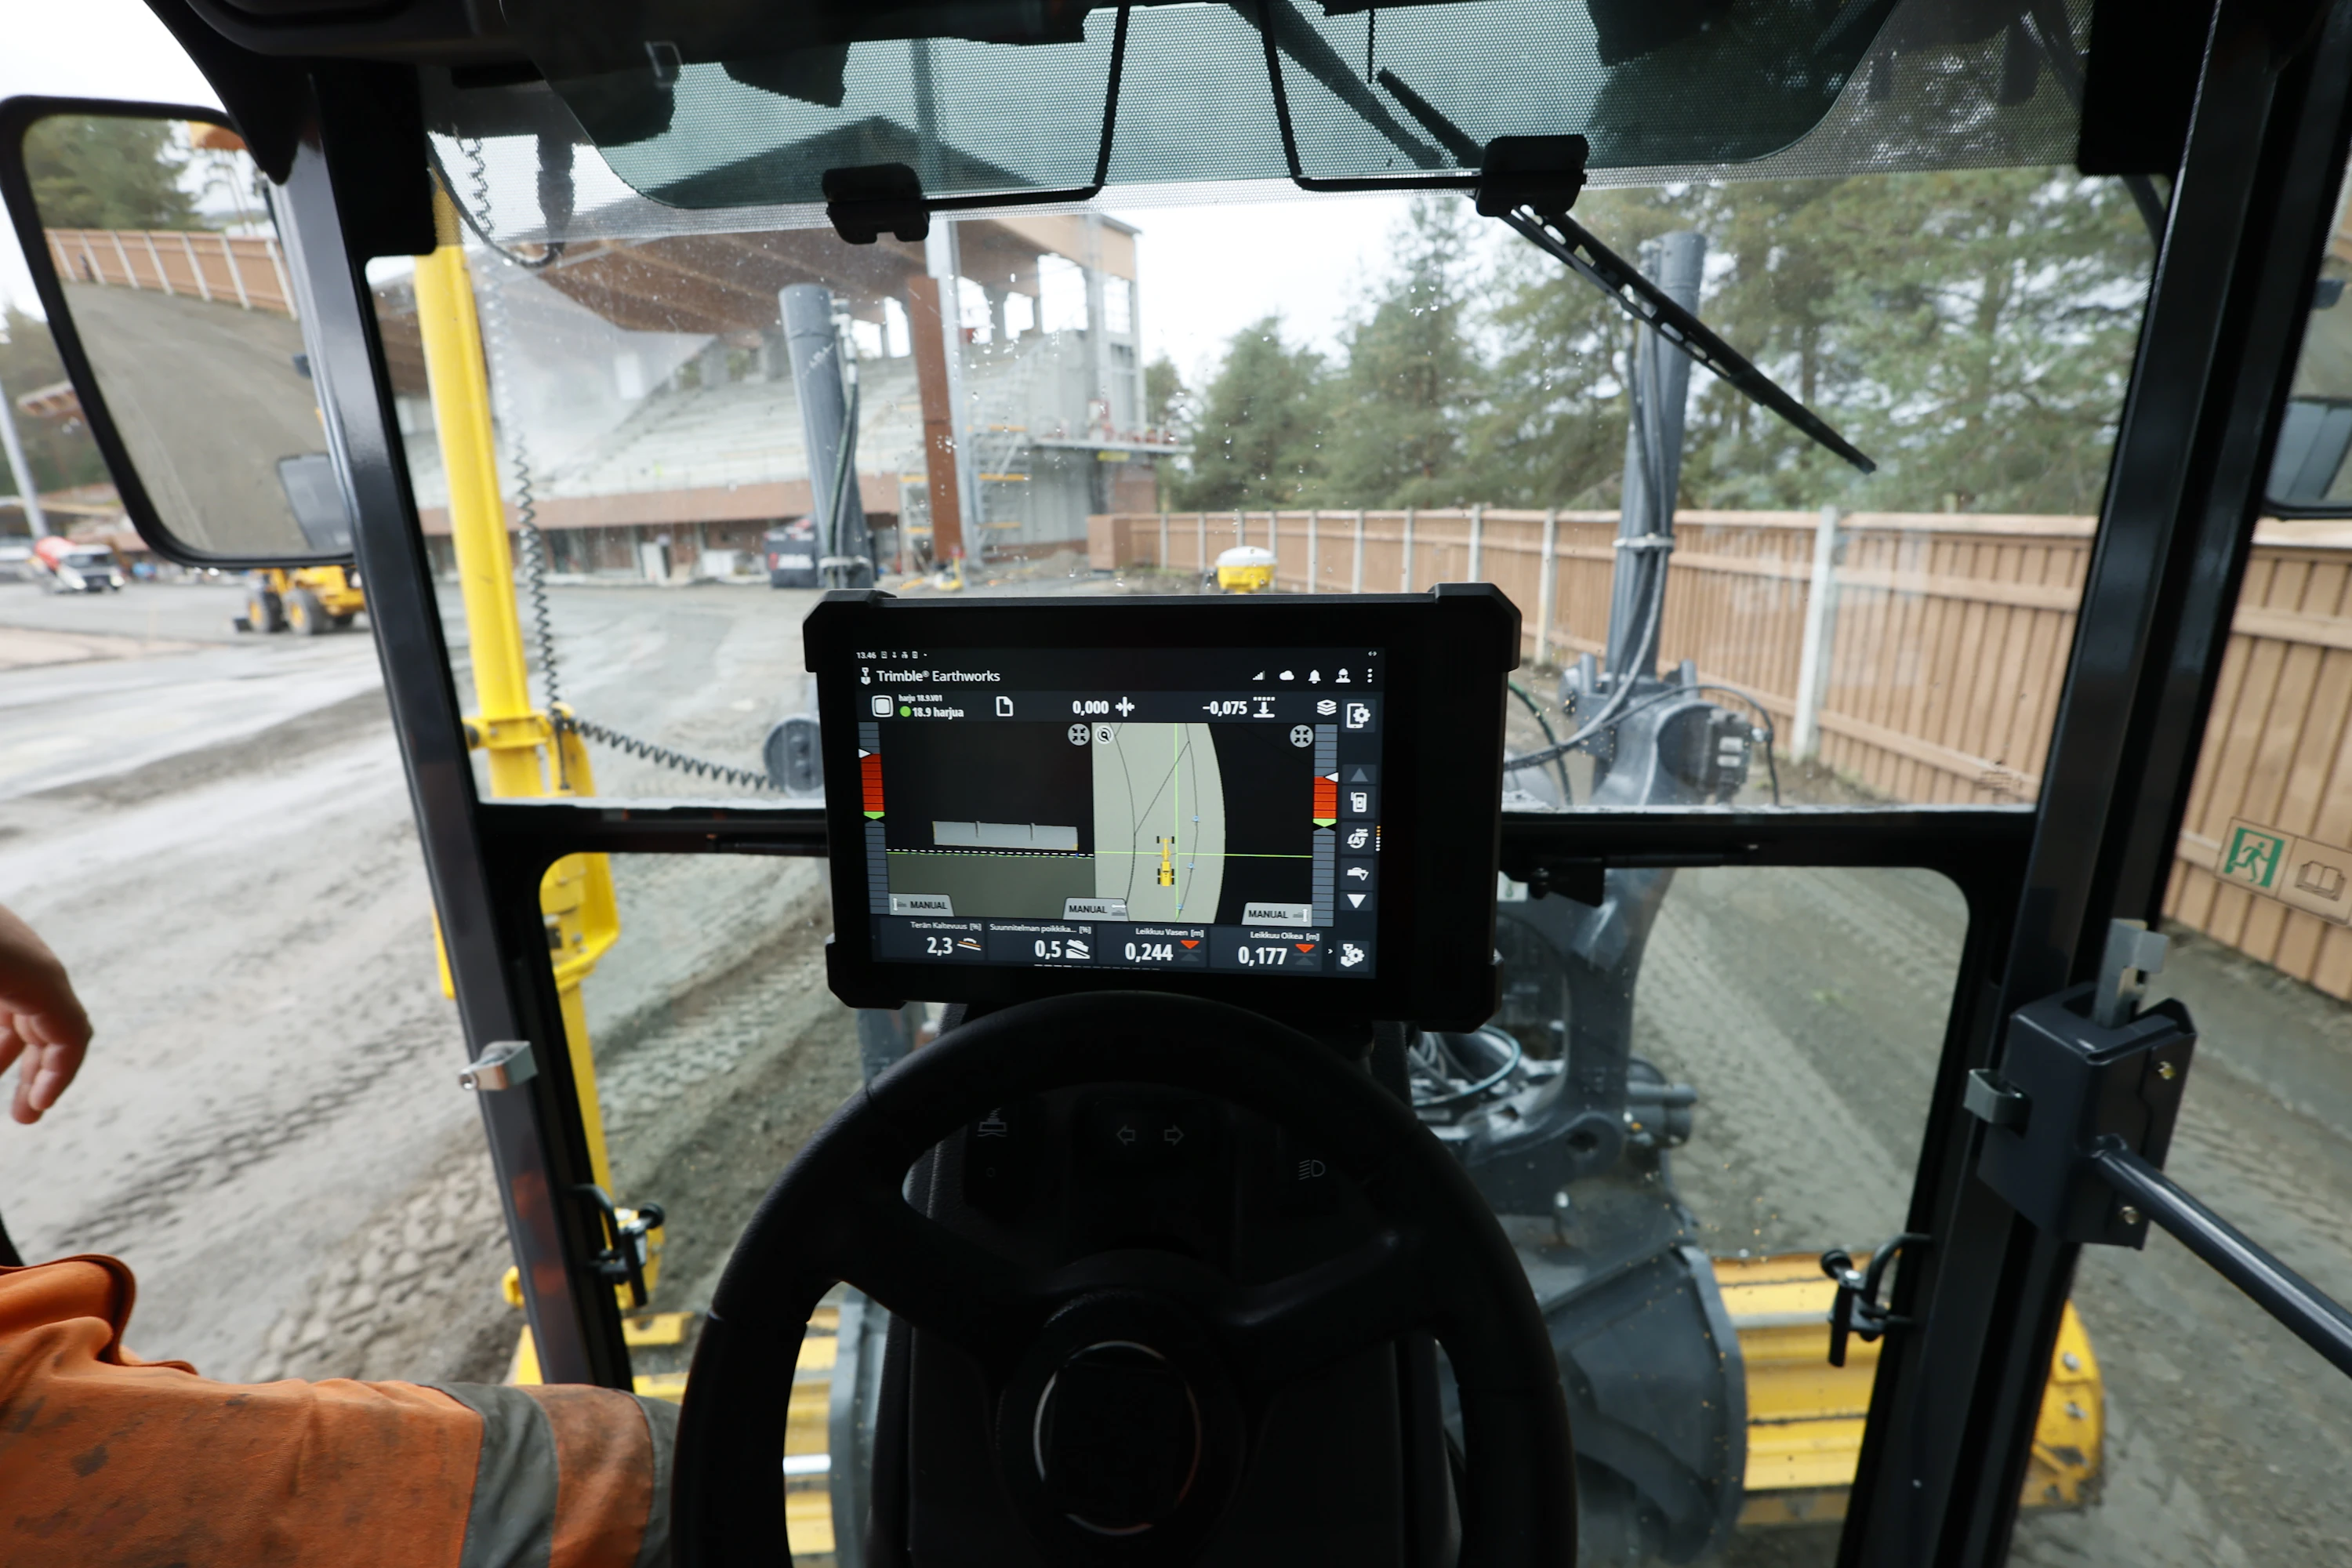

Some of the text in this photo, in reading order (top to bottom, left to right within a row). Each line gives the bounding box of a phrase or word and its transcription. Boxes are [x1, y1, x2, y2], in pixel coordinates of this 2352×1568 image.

[932, 670, 1000, 682] Earthworks
[912, 706, 964, 720] 18.9 harjua
[1072, 700, 1109, 716] 0,000
[1202, 701, 1247, 717] -0,075
[909, 901, 947, 909] MANUAL
[1069, 905, 1107, 914] MANUAL
[1248, 909, 1288, 919] MANUAL
[932, 922, 967, 931] Kaltevuus
[969, 923, 982, 931] [%]
[989, 924, 1040, 932] Suunnitelman
[1079, 926, 1092, 935] [%]
[1190, 929, 1204, 938] [m]
[1305, 933, 1320, 942] [m]
[926, 936, 953, 956] 2,3
[1034, 939, 1062, 960] 0,5
[1124, 942, 1174, 963] 0,244
[1237, 946, 1288, 967] 0,177
